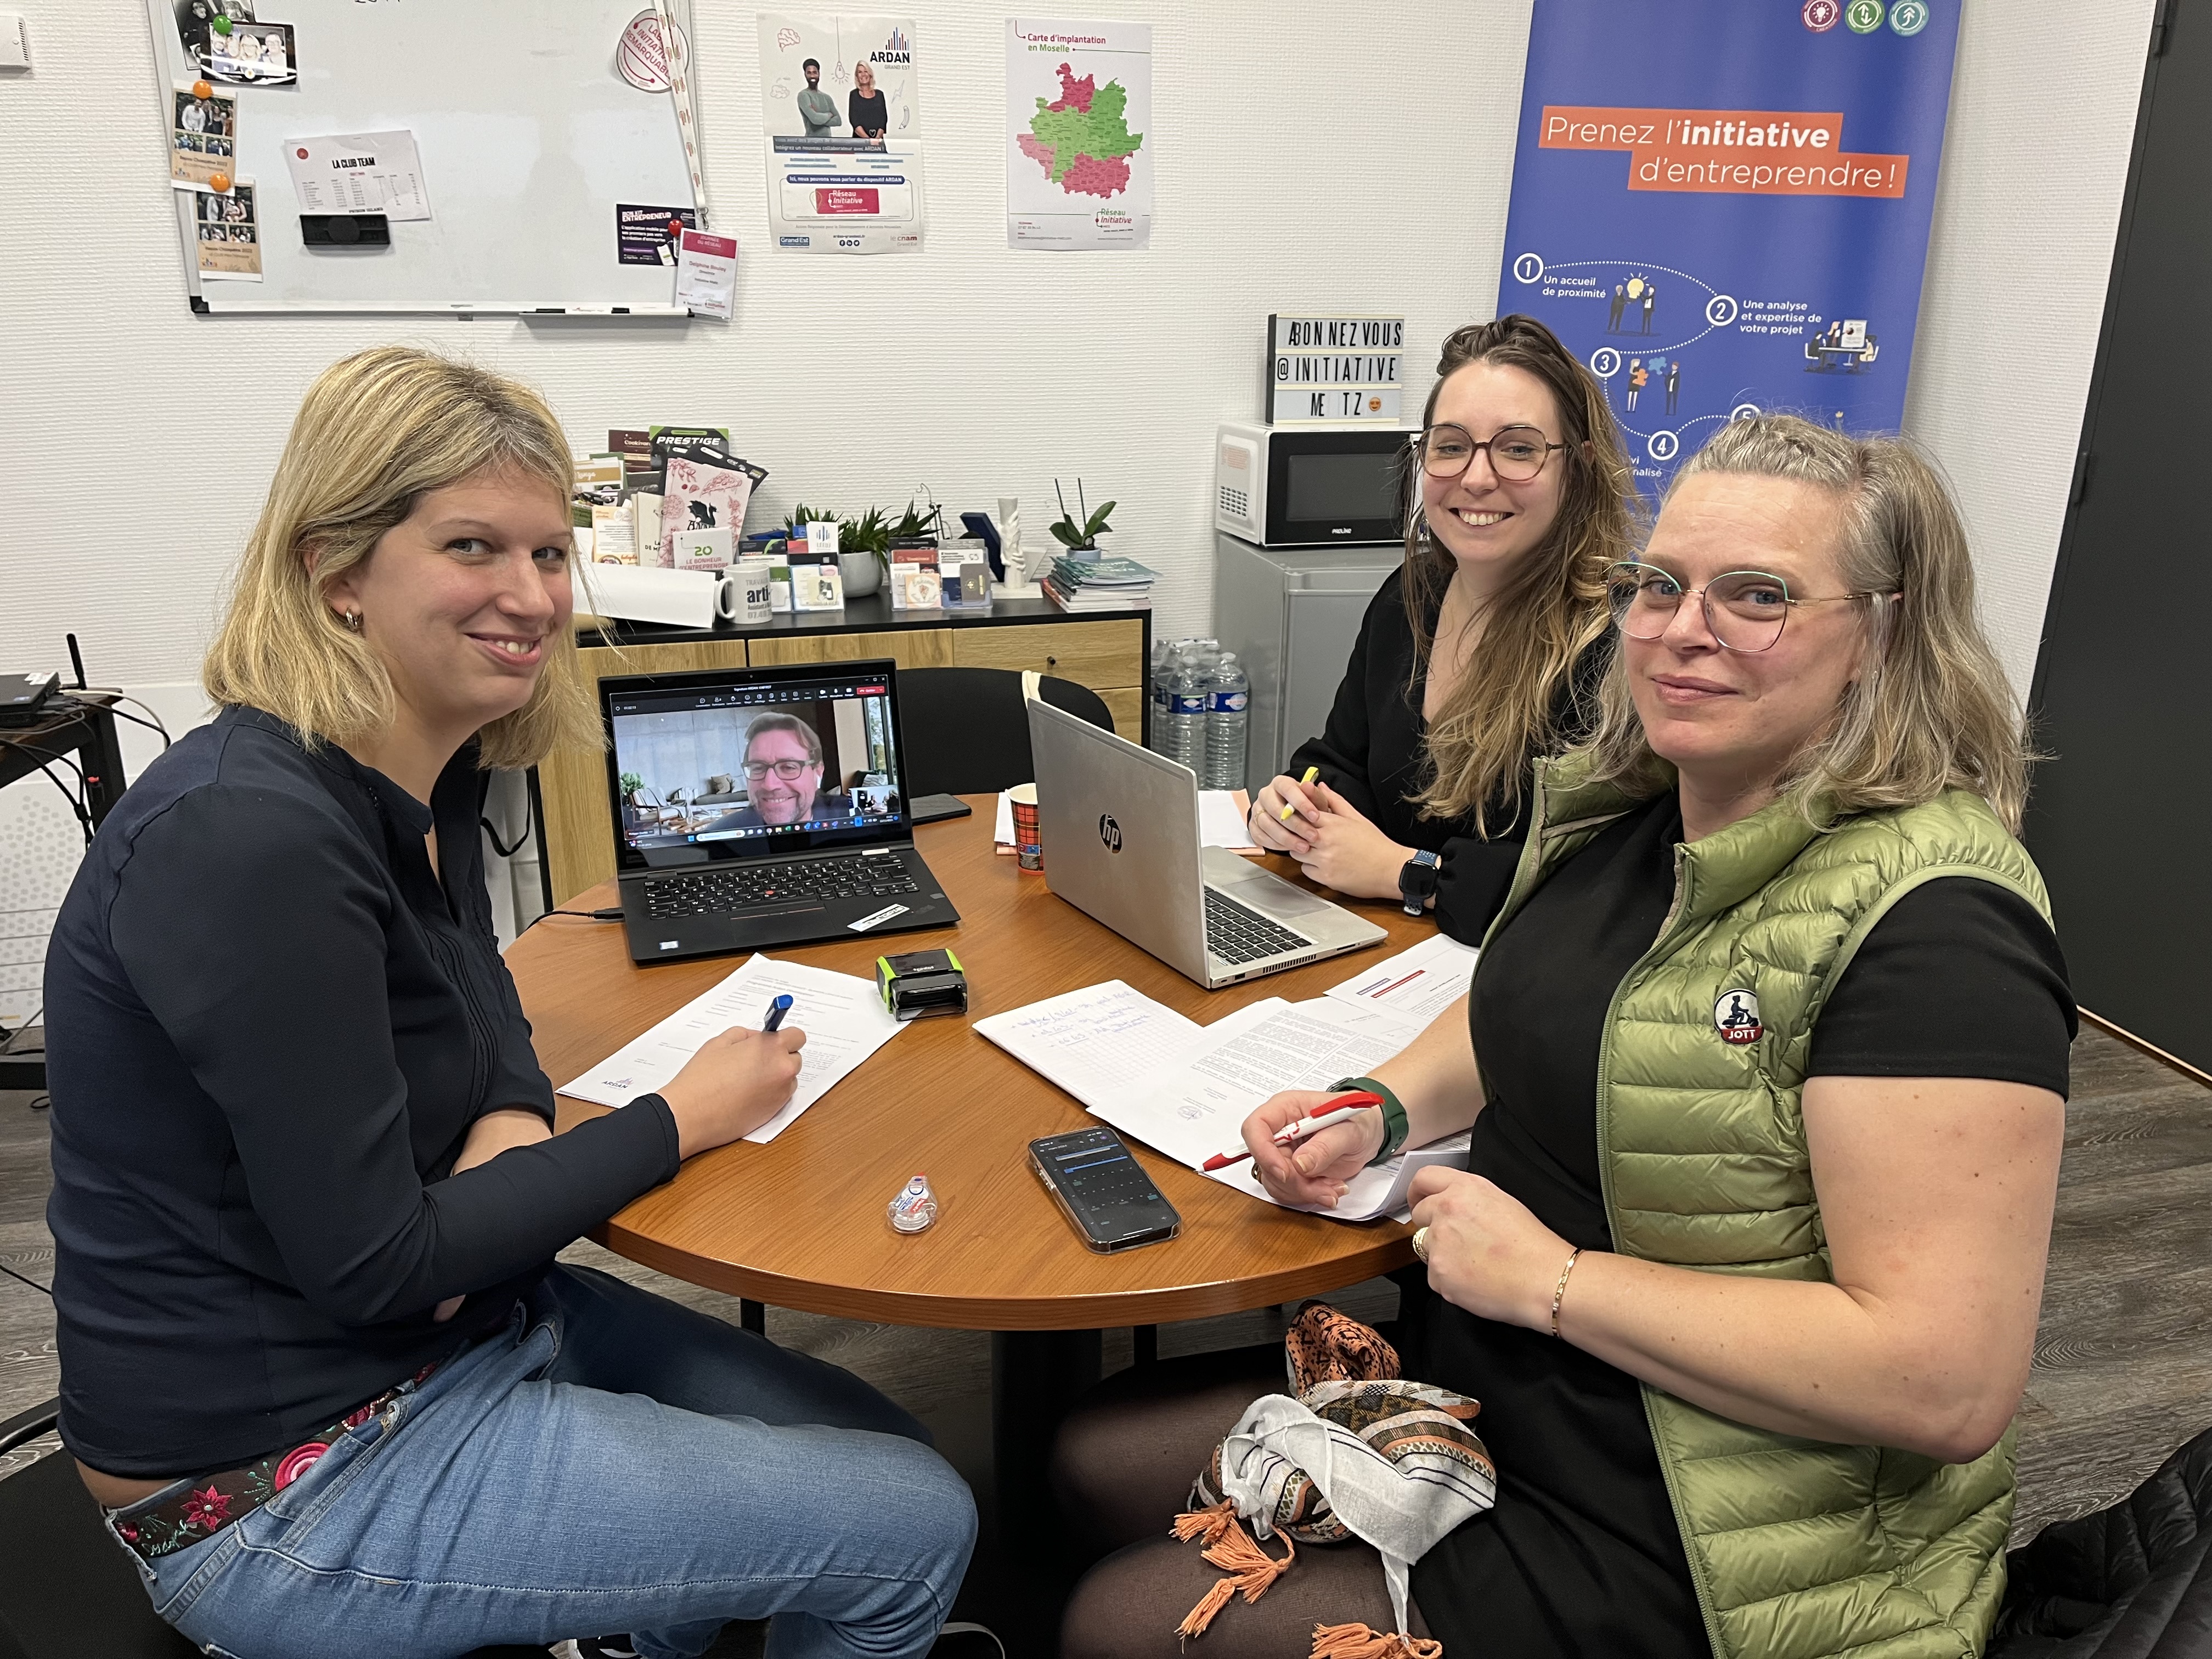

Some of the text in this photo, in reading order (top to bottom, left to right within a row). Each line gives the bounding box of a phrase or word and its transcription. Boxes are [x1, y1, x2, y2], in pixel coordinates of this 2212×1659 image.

[1028, 33, 1106, 44] Carte d'implantation
[636, 29, 667, 62] INITIATIV
[1040, 44, 1070, 53] Moselle
[625, 30, 670, 79] REMARQUABL
[870, 51, 910, 63] ARDAN
[1546, 116, 1830, 148] Prenez l'initiative
[332, 157, 376, 169] LA CLUB TEAM
[622, 212, 672, 222] ENTREPRENEUR
[1525, 261, 1532, 277] 1
[1544, 275, 1596, 286] Un accueil
[1542, 287, 1606, 298] de proximité
[1715, 302, 1726, 319] 2
[1743, 300, 1808, 312] Une analyse
[1741, 312, 1822, 323] et expertise de
[1362, 321, 1402, 346] VOUS
[1740, 324, 1803, 335] votre projet
[1600, 354, 1610, 371] 3
[656, 436, 721, 445] PRESTIGE
[1657, 437, 1667, 454] 4
[695, 546, 713, 556] 20
[1102, 814, 1120, 851] hp
[1728, 1029, 1756, 1039] JOTT
